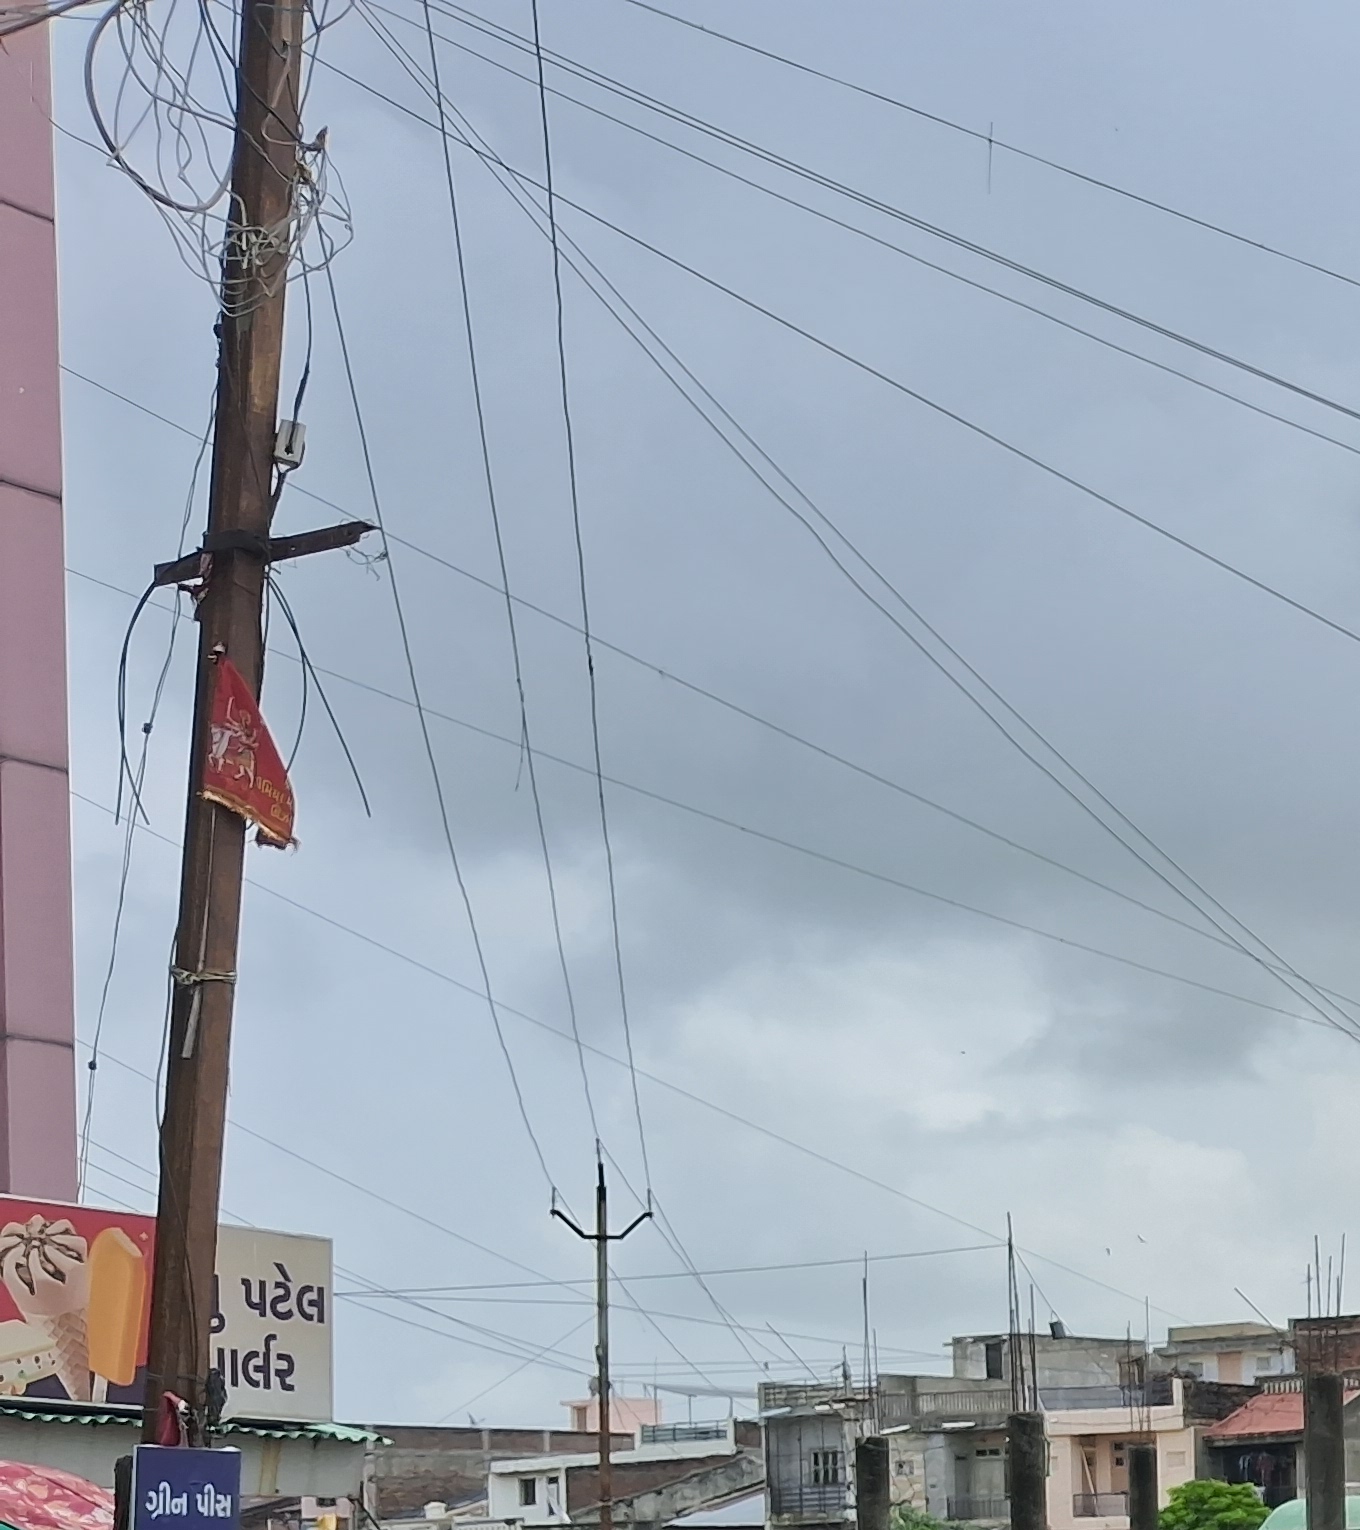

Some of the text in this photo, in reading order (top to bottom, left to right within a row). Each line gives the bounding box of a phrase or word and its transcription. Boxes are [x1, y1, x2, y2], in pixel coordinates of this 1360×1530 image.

[241, 1262, 325, 1324] પટેલ
[145, 1481, 232, 1520] ગ્રીન પીસ
